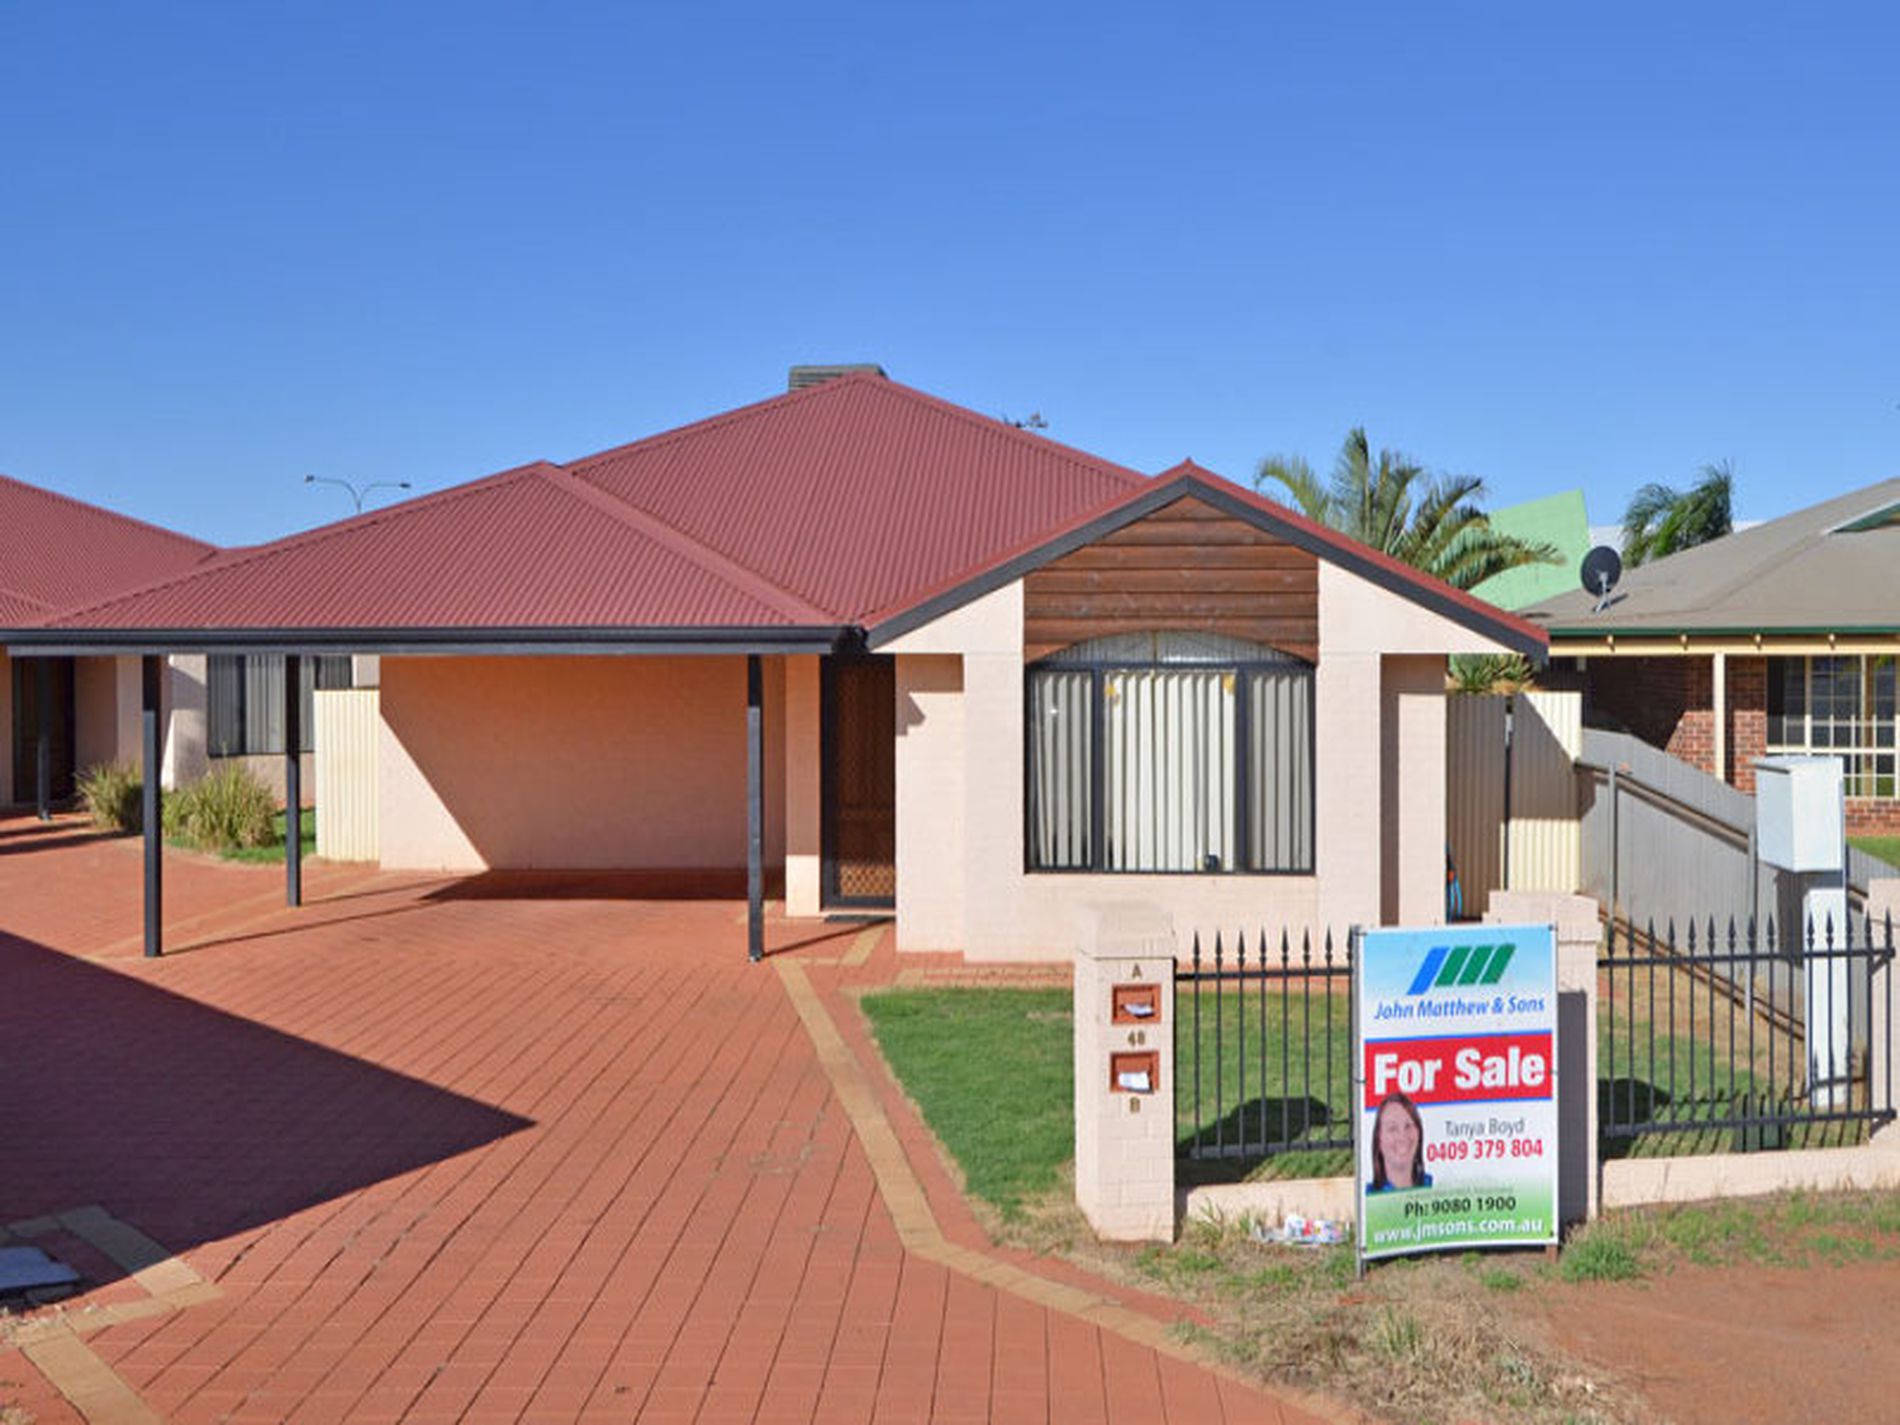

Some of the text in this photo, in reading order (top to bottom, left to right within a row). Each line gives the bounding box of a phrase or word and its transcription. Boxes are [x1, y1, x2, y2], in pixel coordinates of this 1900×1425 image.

[1132, 963, 1142, 978] A
[1374, 996, 1545, 1019] John Matthew & Sons
[1374, 1046, 1546, 1096] For Sale
[1445, 1117, 1525, 1139] Tanya Boyd
[1427, 1138, 1543, 1162] 0409 379 804
[1477, 1196, 1516, 1212] 1900
[1374, 1217, 1543, 1243] www.jmsons.com.au
